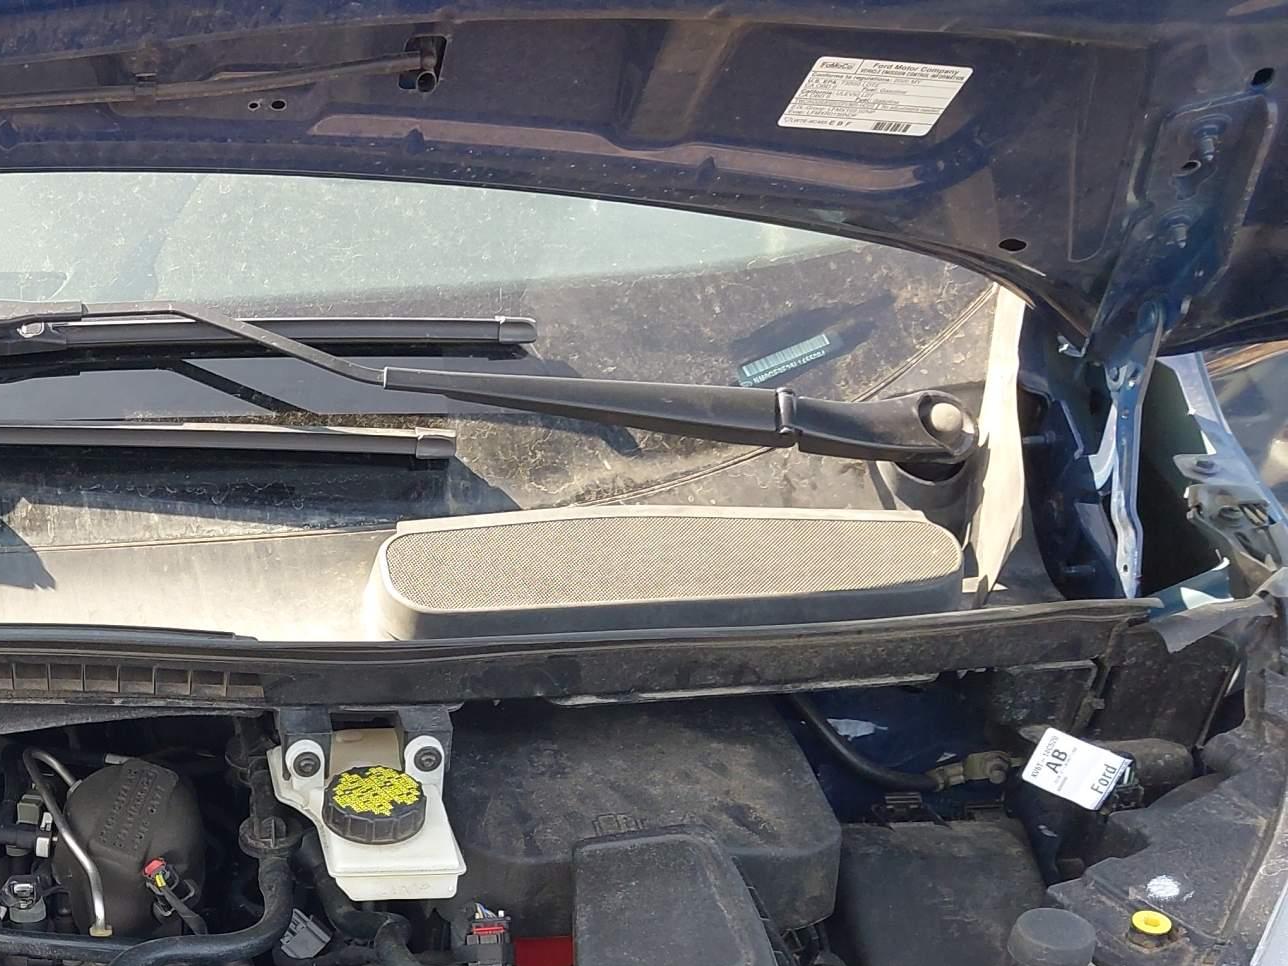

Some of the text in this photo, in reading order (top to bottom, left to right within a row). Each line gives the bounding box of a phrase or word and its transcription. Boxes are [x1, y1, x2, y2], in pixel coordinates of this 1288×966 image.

[872, 62, 893, 70] Ford
[920, 66, 960, 76] Company
[1045, 749, 1068, 774] AB
[1090, 763, 1117, 794] Ford
